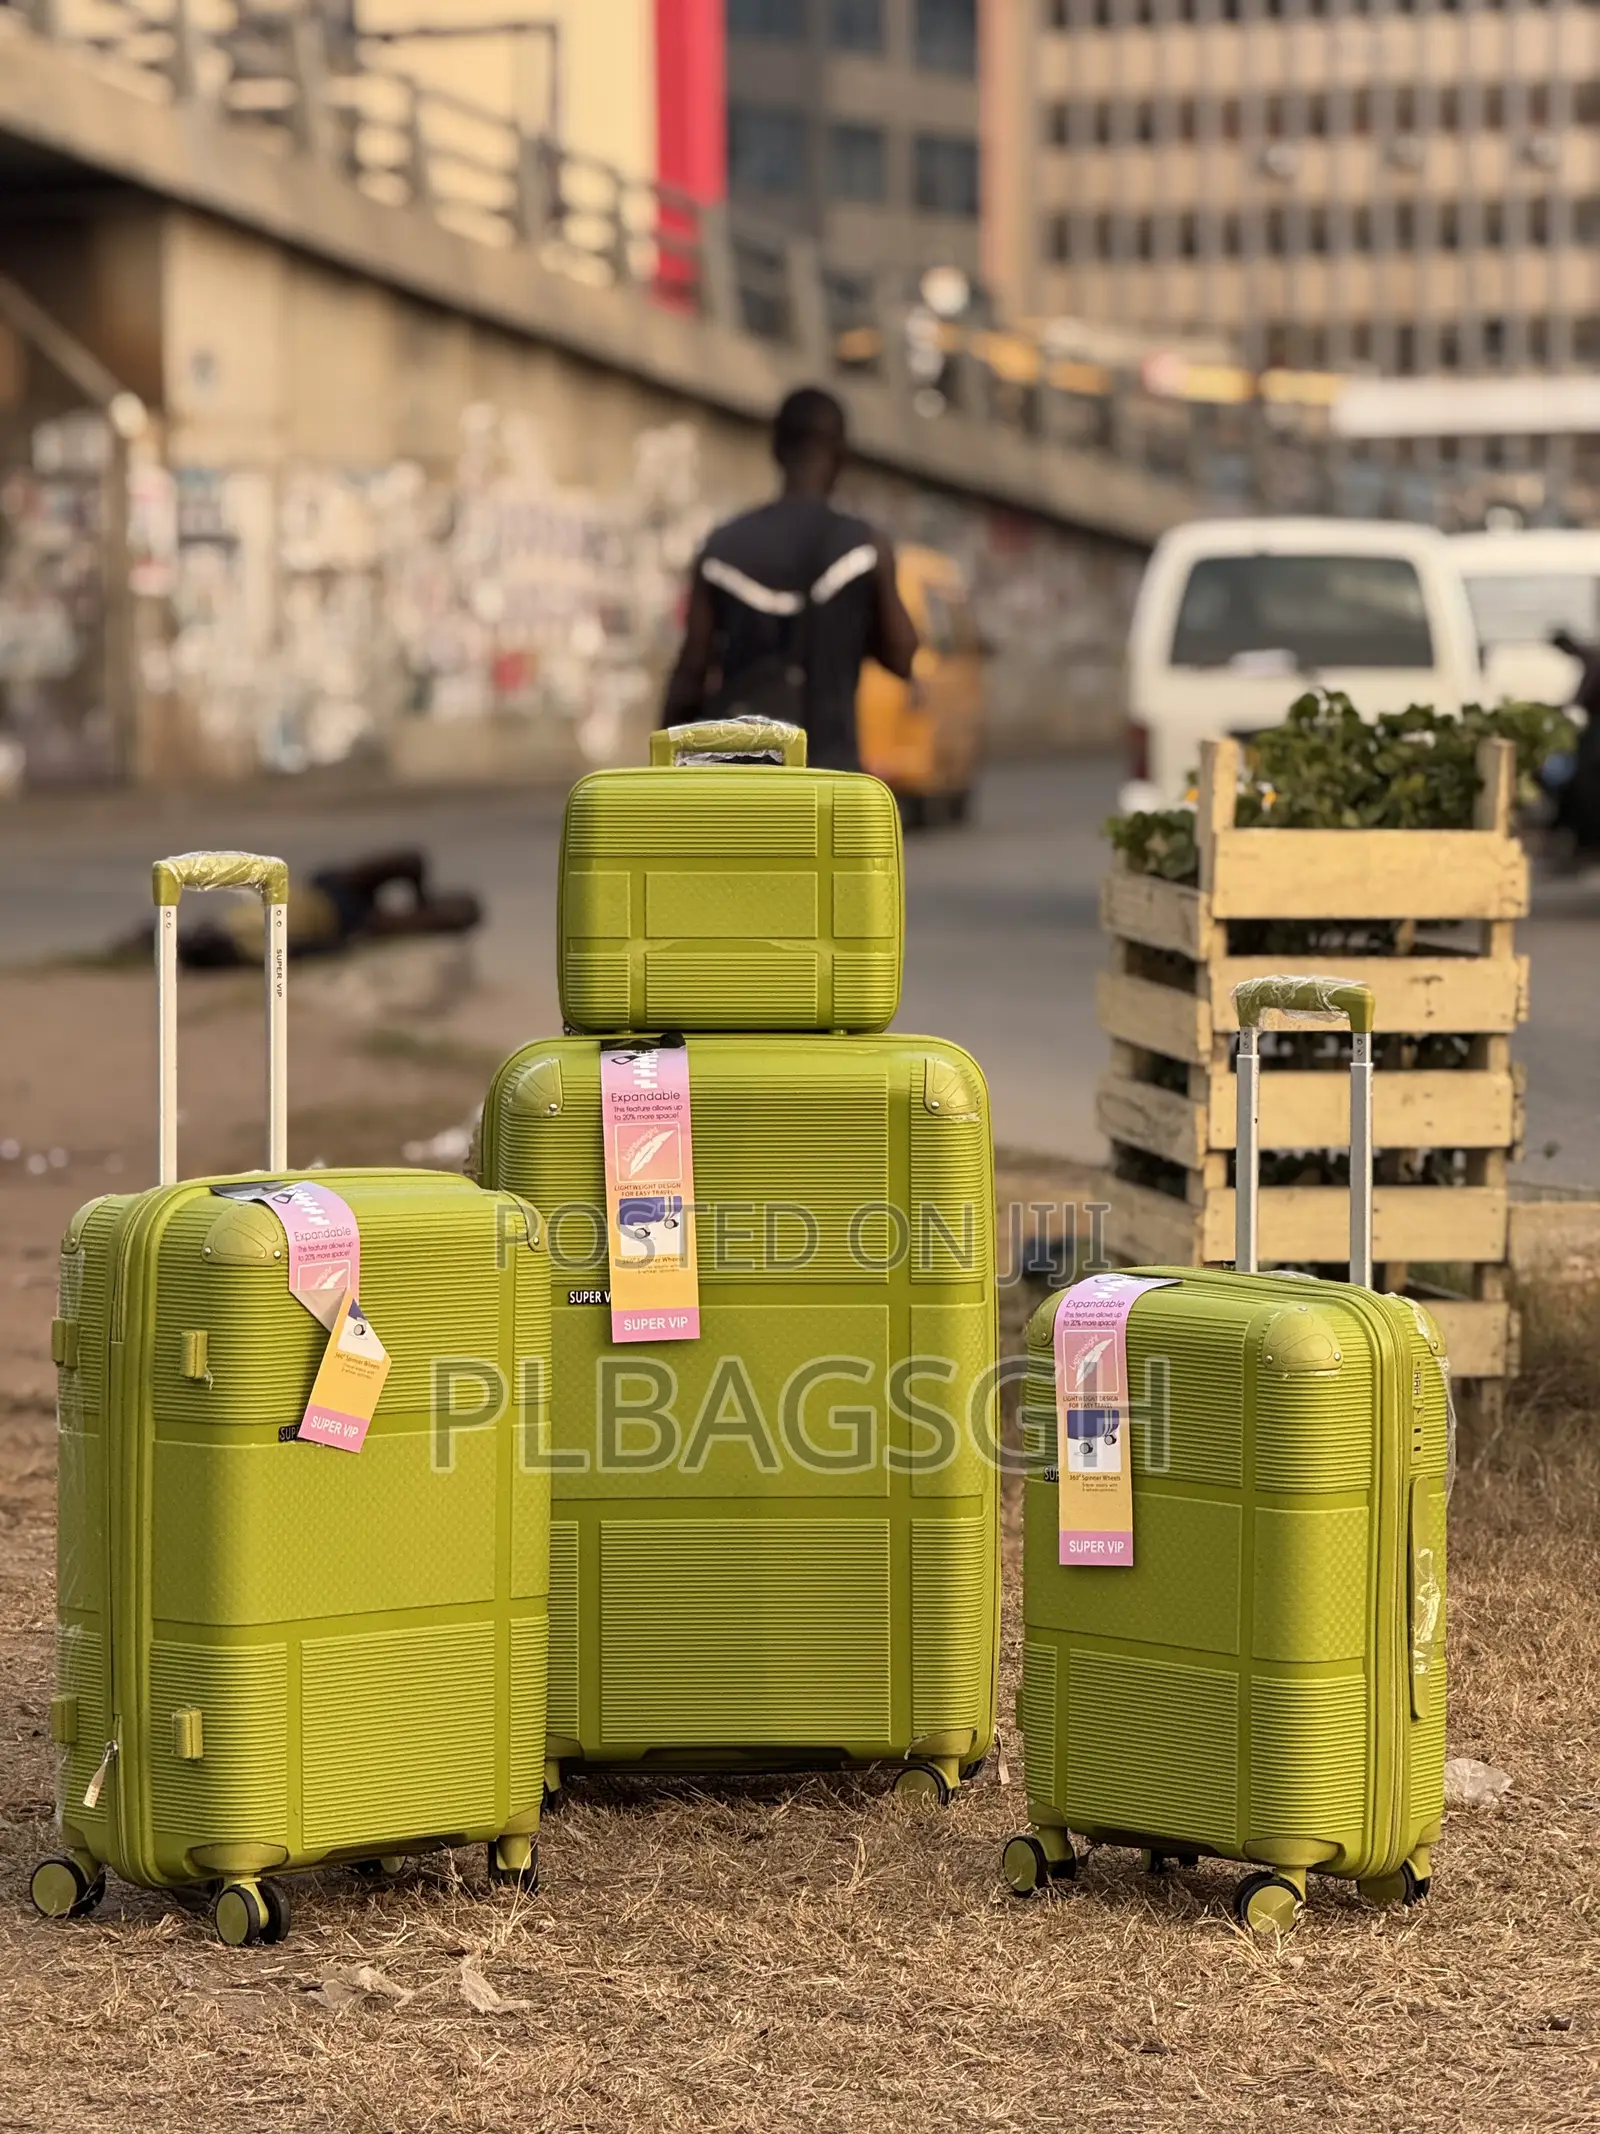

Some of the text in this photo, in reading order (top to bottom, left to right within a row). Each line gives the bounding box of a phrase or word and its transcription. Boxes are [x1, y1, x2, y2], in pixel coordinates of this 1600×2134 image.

[611, 1091, 681, 1103] Expandable
[294, 1226, 352, 1242] Expandable
[308, 1244, 328, 1252] feature
[570, 1291, 602, 1303] SUPER
[1066, 1299, 1126, 1309] Expandable
[624, 1316, 688, 1331] SUPER VIP
[1070, 1319, 1081, 1327] 20%
[311, 1416, 359, 1438] SUPER VIP
[1069, 1540, 1124, 1554] SUPER VIP
